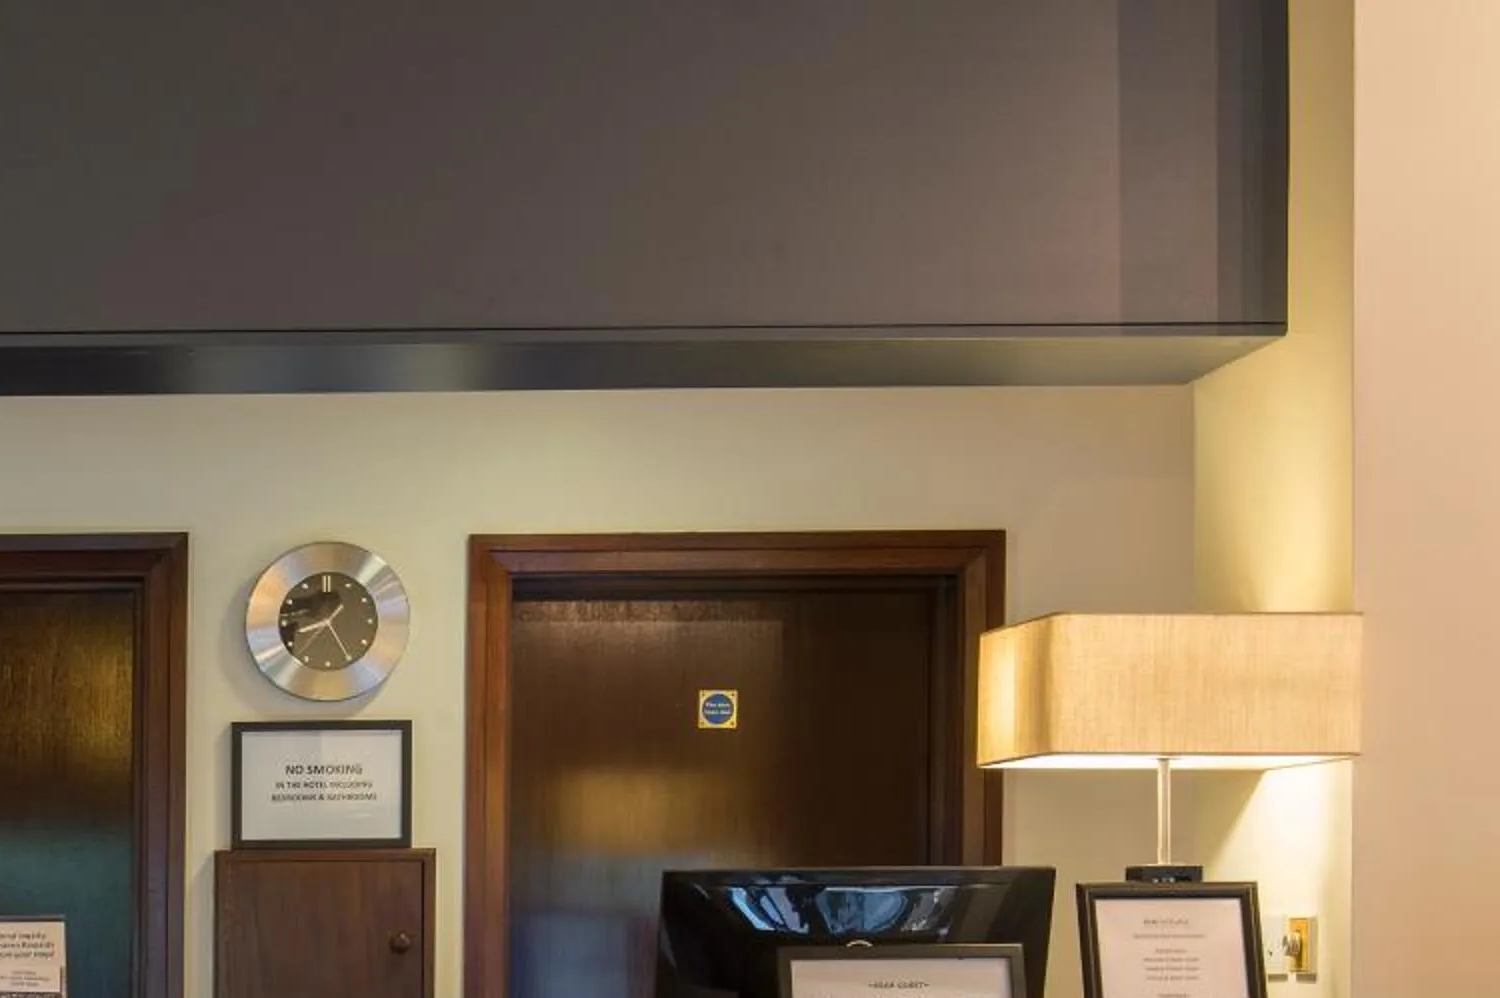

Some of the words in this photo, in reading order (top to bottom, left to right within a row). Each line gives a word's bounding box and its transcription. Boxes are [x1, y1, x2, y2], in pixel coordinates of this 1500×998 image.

[285, 764, 304, 775] NO
[305, 764, 363, 775] SMOKING
[275, 781, 285, 789] IN
[287, 781, 301, 789] THE
[303, 781, 328, 789] HOTEL
[318, 793, 325, 801] &
